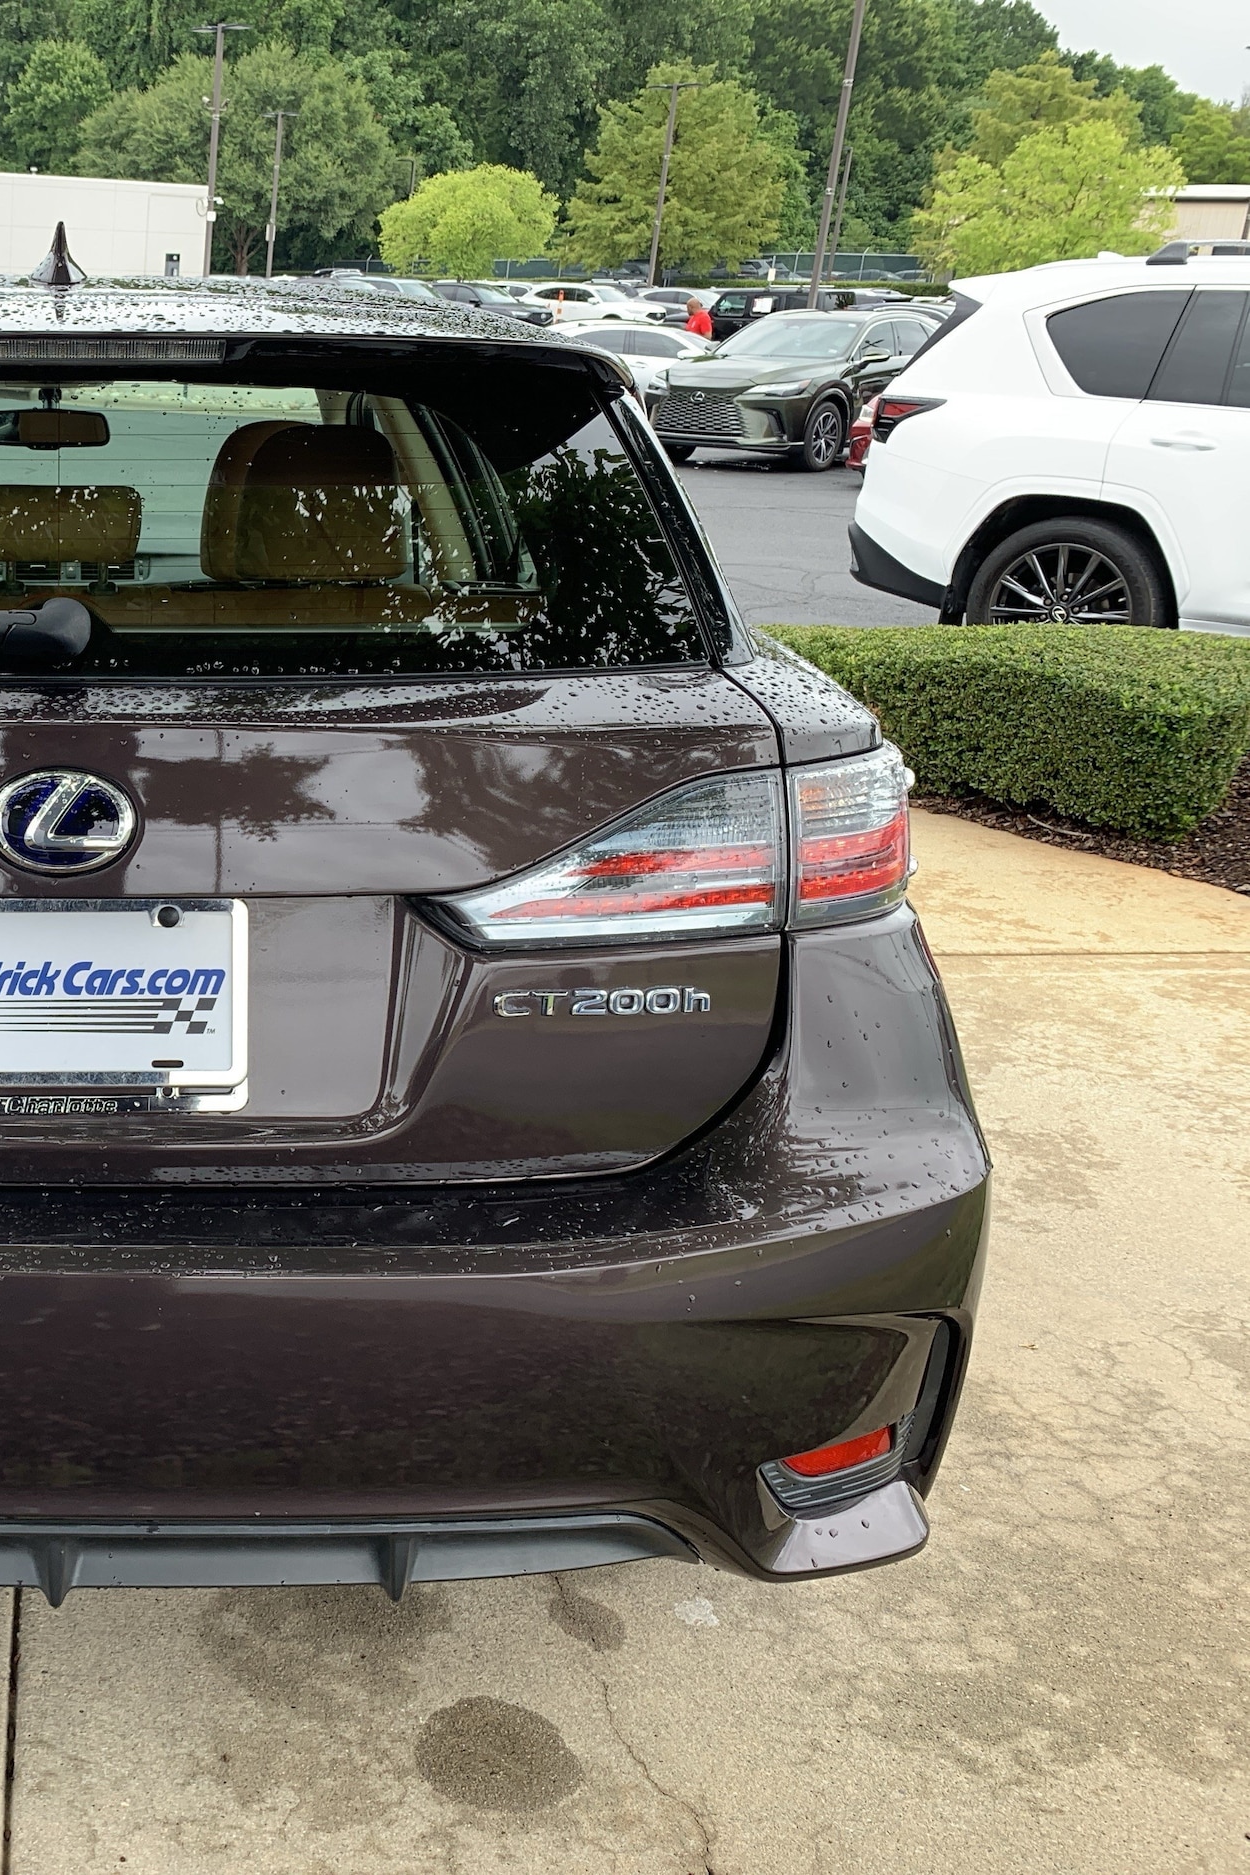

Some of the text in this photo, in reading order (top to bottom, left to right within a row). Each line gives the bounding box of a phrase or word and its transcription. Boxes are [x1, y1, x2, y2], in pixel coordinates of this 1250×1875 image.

[493, 986, 711, 1017] CT 200h
[4, 1096, 118, 1113] Charlotte
